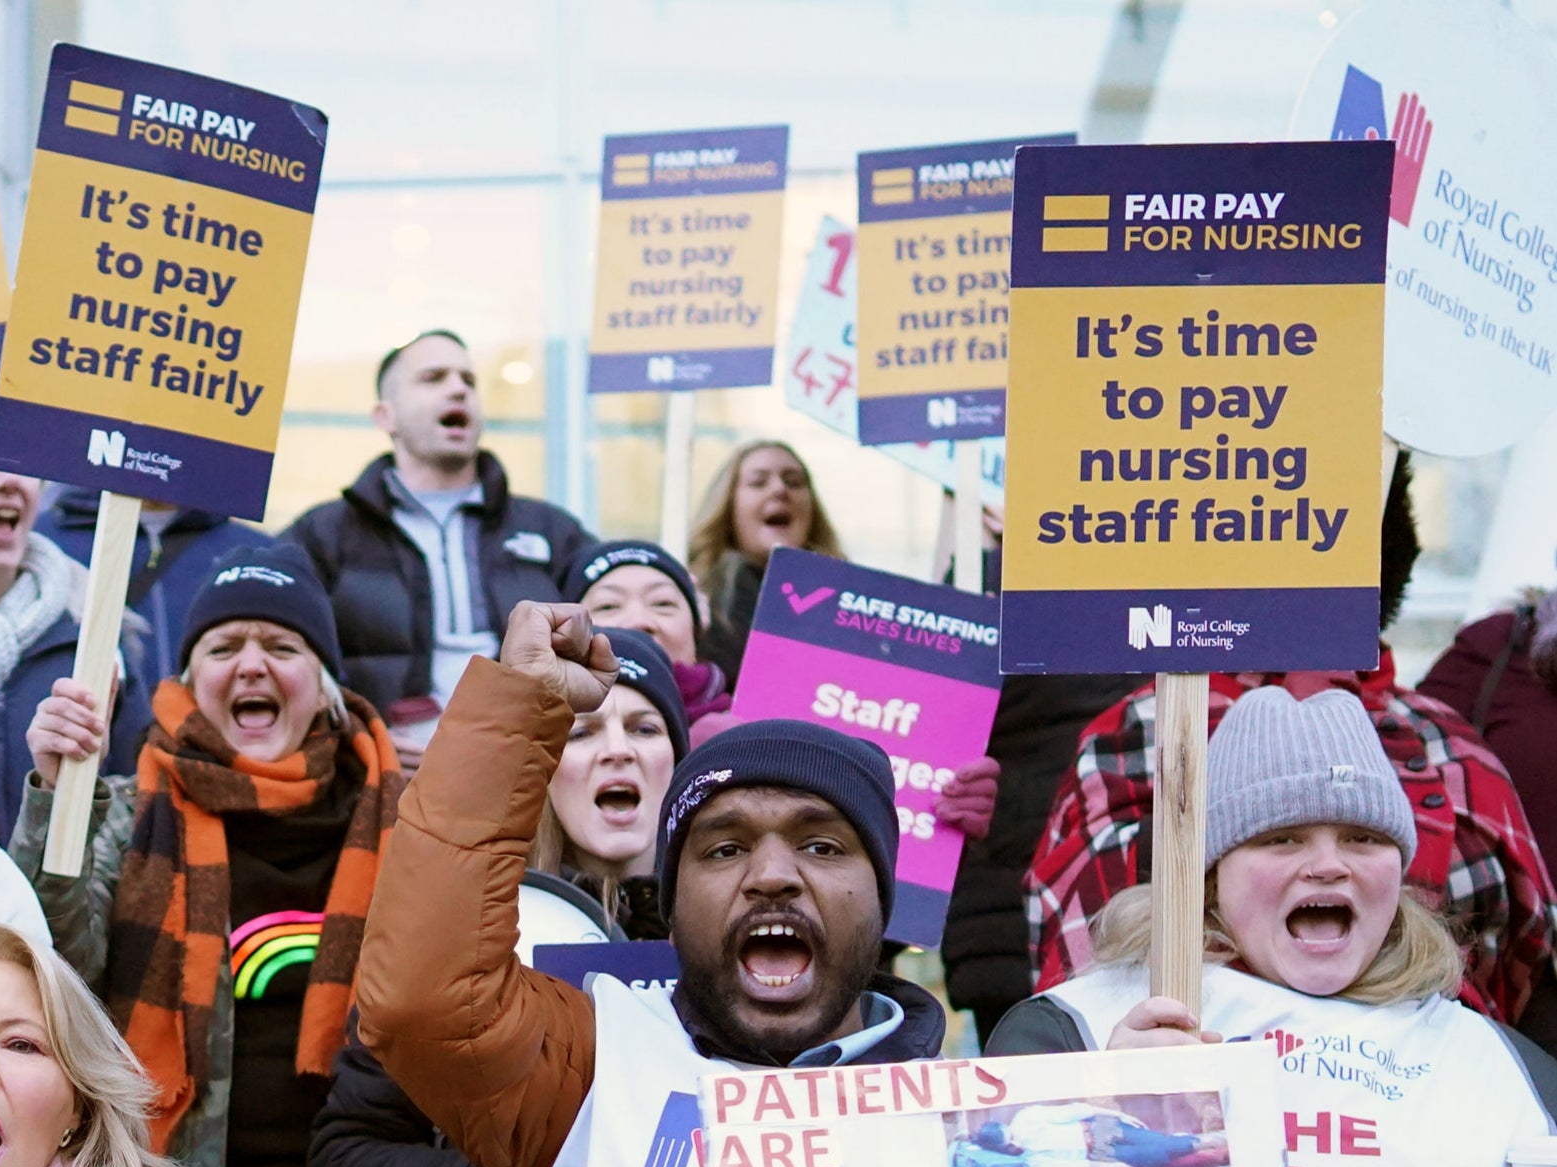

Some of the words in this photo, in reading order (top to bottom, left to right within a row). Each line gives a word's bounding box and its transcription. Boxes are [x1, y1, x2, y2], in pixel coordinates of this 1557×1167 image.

[132, 94, 198, 129] FAIR
[201, 112, 256, 143] PAY
[129, 120, 185, 151] FOR
[190, 135, 306, 183] NURSING
[80, 184, 149, 229] It's
[162, 202, 264, 256] time
[682, 210, 751, 232] time
[1124, 193, 1207, 221] FAIR
[1214, 192, 1284, 220] PAY
[1435, 169, 1498, 231] Royal
[643, 244, 673, 265] to
[680, 243, 735, 268] pay
[896, 235, 945, 261] It's
[1124, 225, 1192, 252] FOR
[1204, 223, 1363, 251] NURSING
[96, 243, 143, 280] to
[153, 258, 237, 308] pay
[629, 271, 743, 298] nursing
[912, 273, 946, 295] to
[1423, 219, 1449, 246] of
[1453, 234, 1535, 314] Nursing
[69, 291, 243, 362] nursing
[607, 303, 676, 328] staff
[684, 302, 761, 328] fairly
[1075, 313, 1164, 358] It's
[1178, 310, 1318, 356] time
[1395, 267, 1419, 291] of
[1418, 275, 1478, 339] nursing
[1482, 314, 1496, 341] in
[1500, 325, 1527, 360] the
[1528, 345, 1553, 375] UK
[28, 336, 142, 384] staff
[150, 353, 265, 417] fairly
[876, 339, 956, 368] staff
[1101, 380, 1164, 419] to
[1179, 384, 1288, 430] pay
[1079, 433, 1307, 491] nursing
[1037, 499, 1178, 544] staff
[1191, 495, 1349, 553] fairly
[835, 609, 900, 640] SAVES
[903, 625, 962, 655] LIVES
[839, 591, 895, 621] SAFE
[897, 605, 999, 646] STAFFING
[1176, 634, 1189, 647] of
[1191, 633, 1234, 651] Nursing
[1177, 620, 1208, 637] Royal
[1210, 619, 1250, 638] College
[810, 682, 922, 736] Staff
[714, 1060, 1008, 1124] PATIENTS
